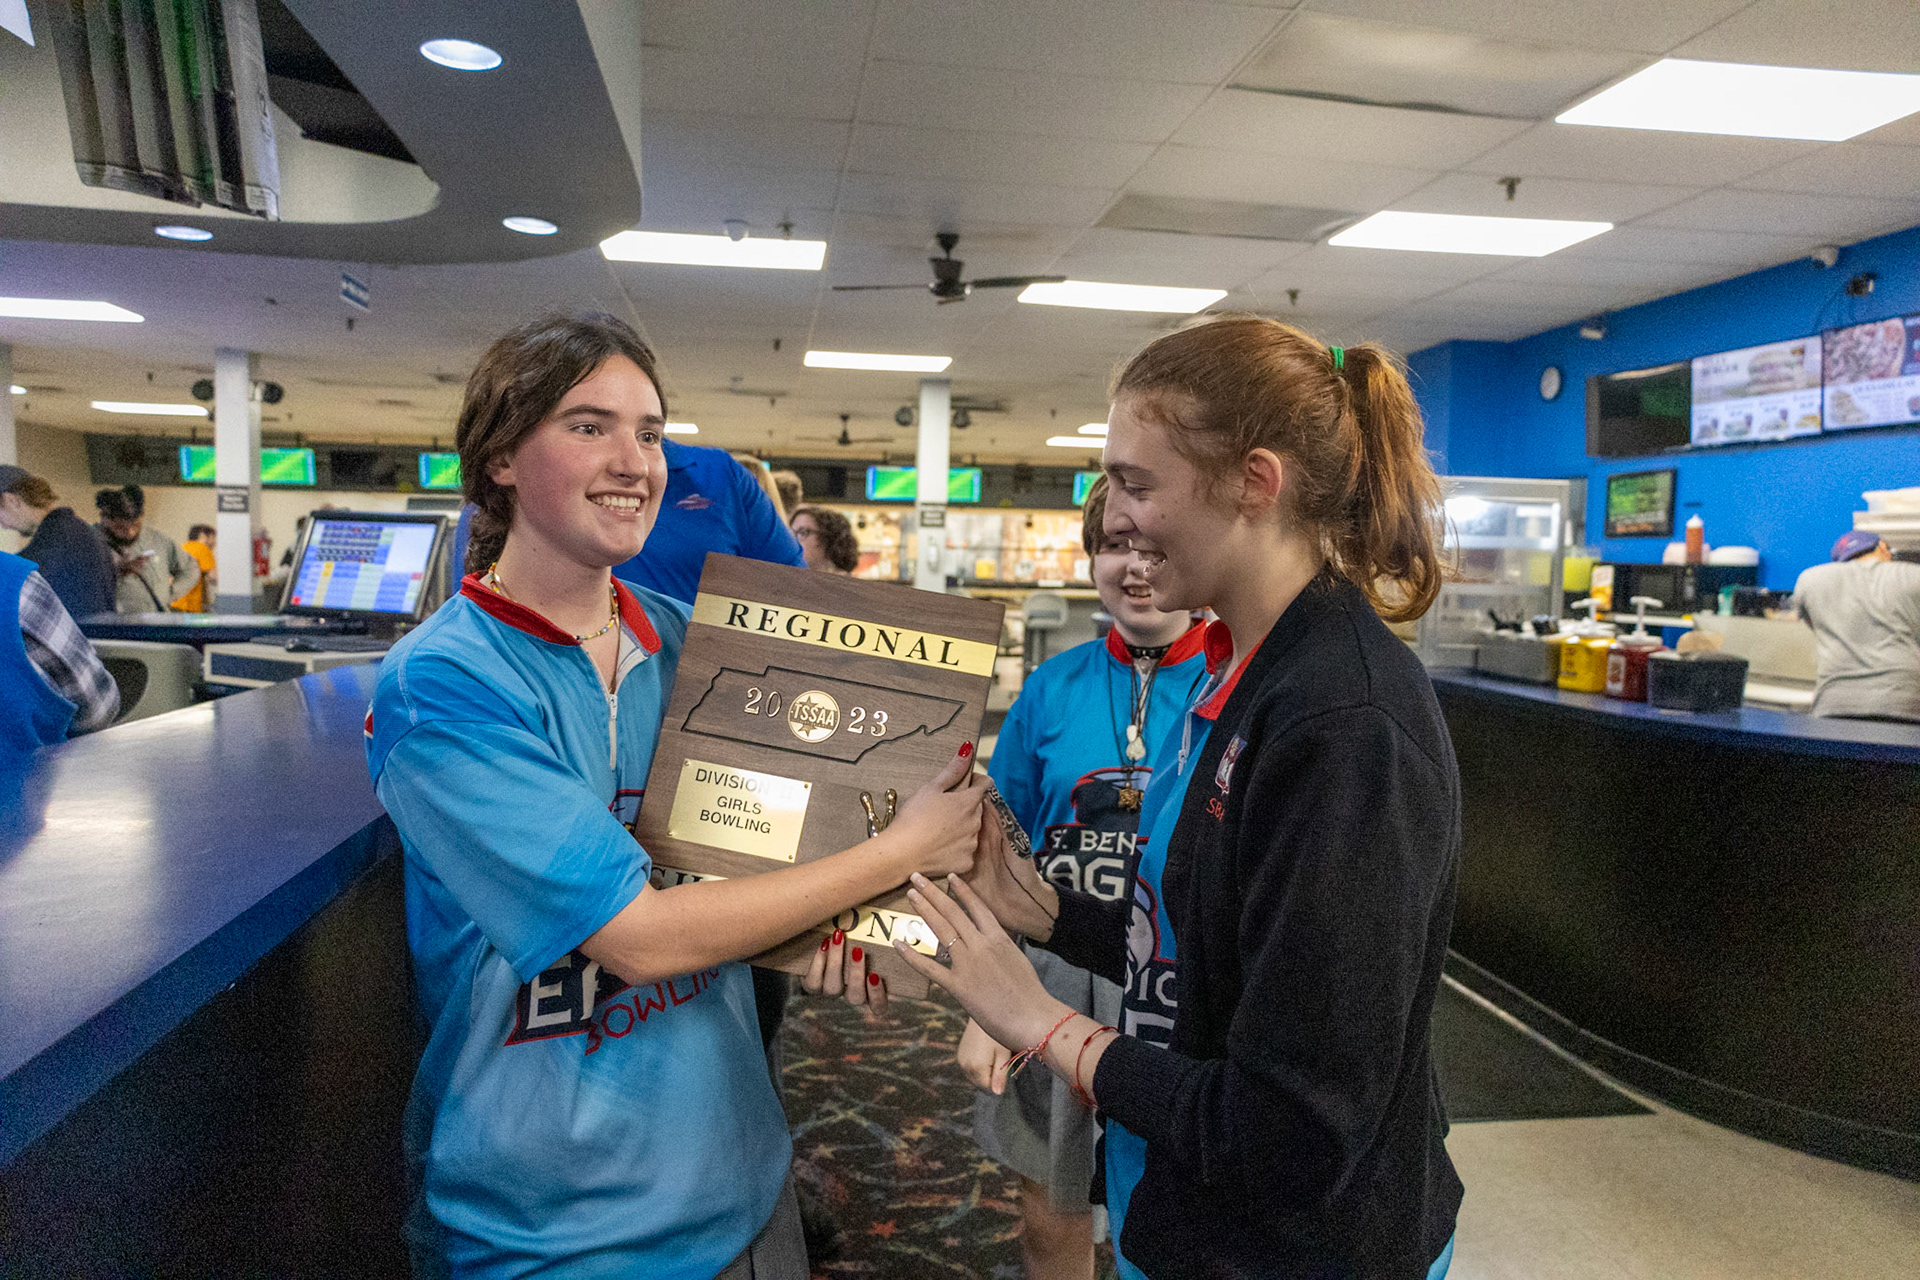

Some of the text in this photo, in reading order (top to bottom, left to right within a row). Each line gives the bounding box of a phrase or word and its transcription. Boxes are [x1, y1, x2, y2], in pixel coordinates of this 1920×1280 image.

[724, 602, 960, 667] REGIONAL
[793, 703, 835, 727] TSSAA
[695, 768, 771, 796] DIVISION
[717, 795, 762, 815] GIRLS
[699, 809, 772, 835] BOWLING
